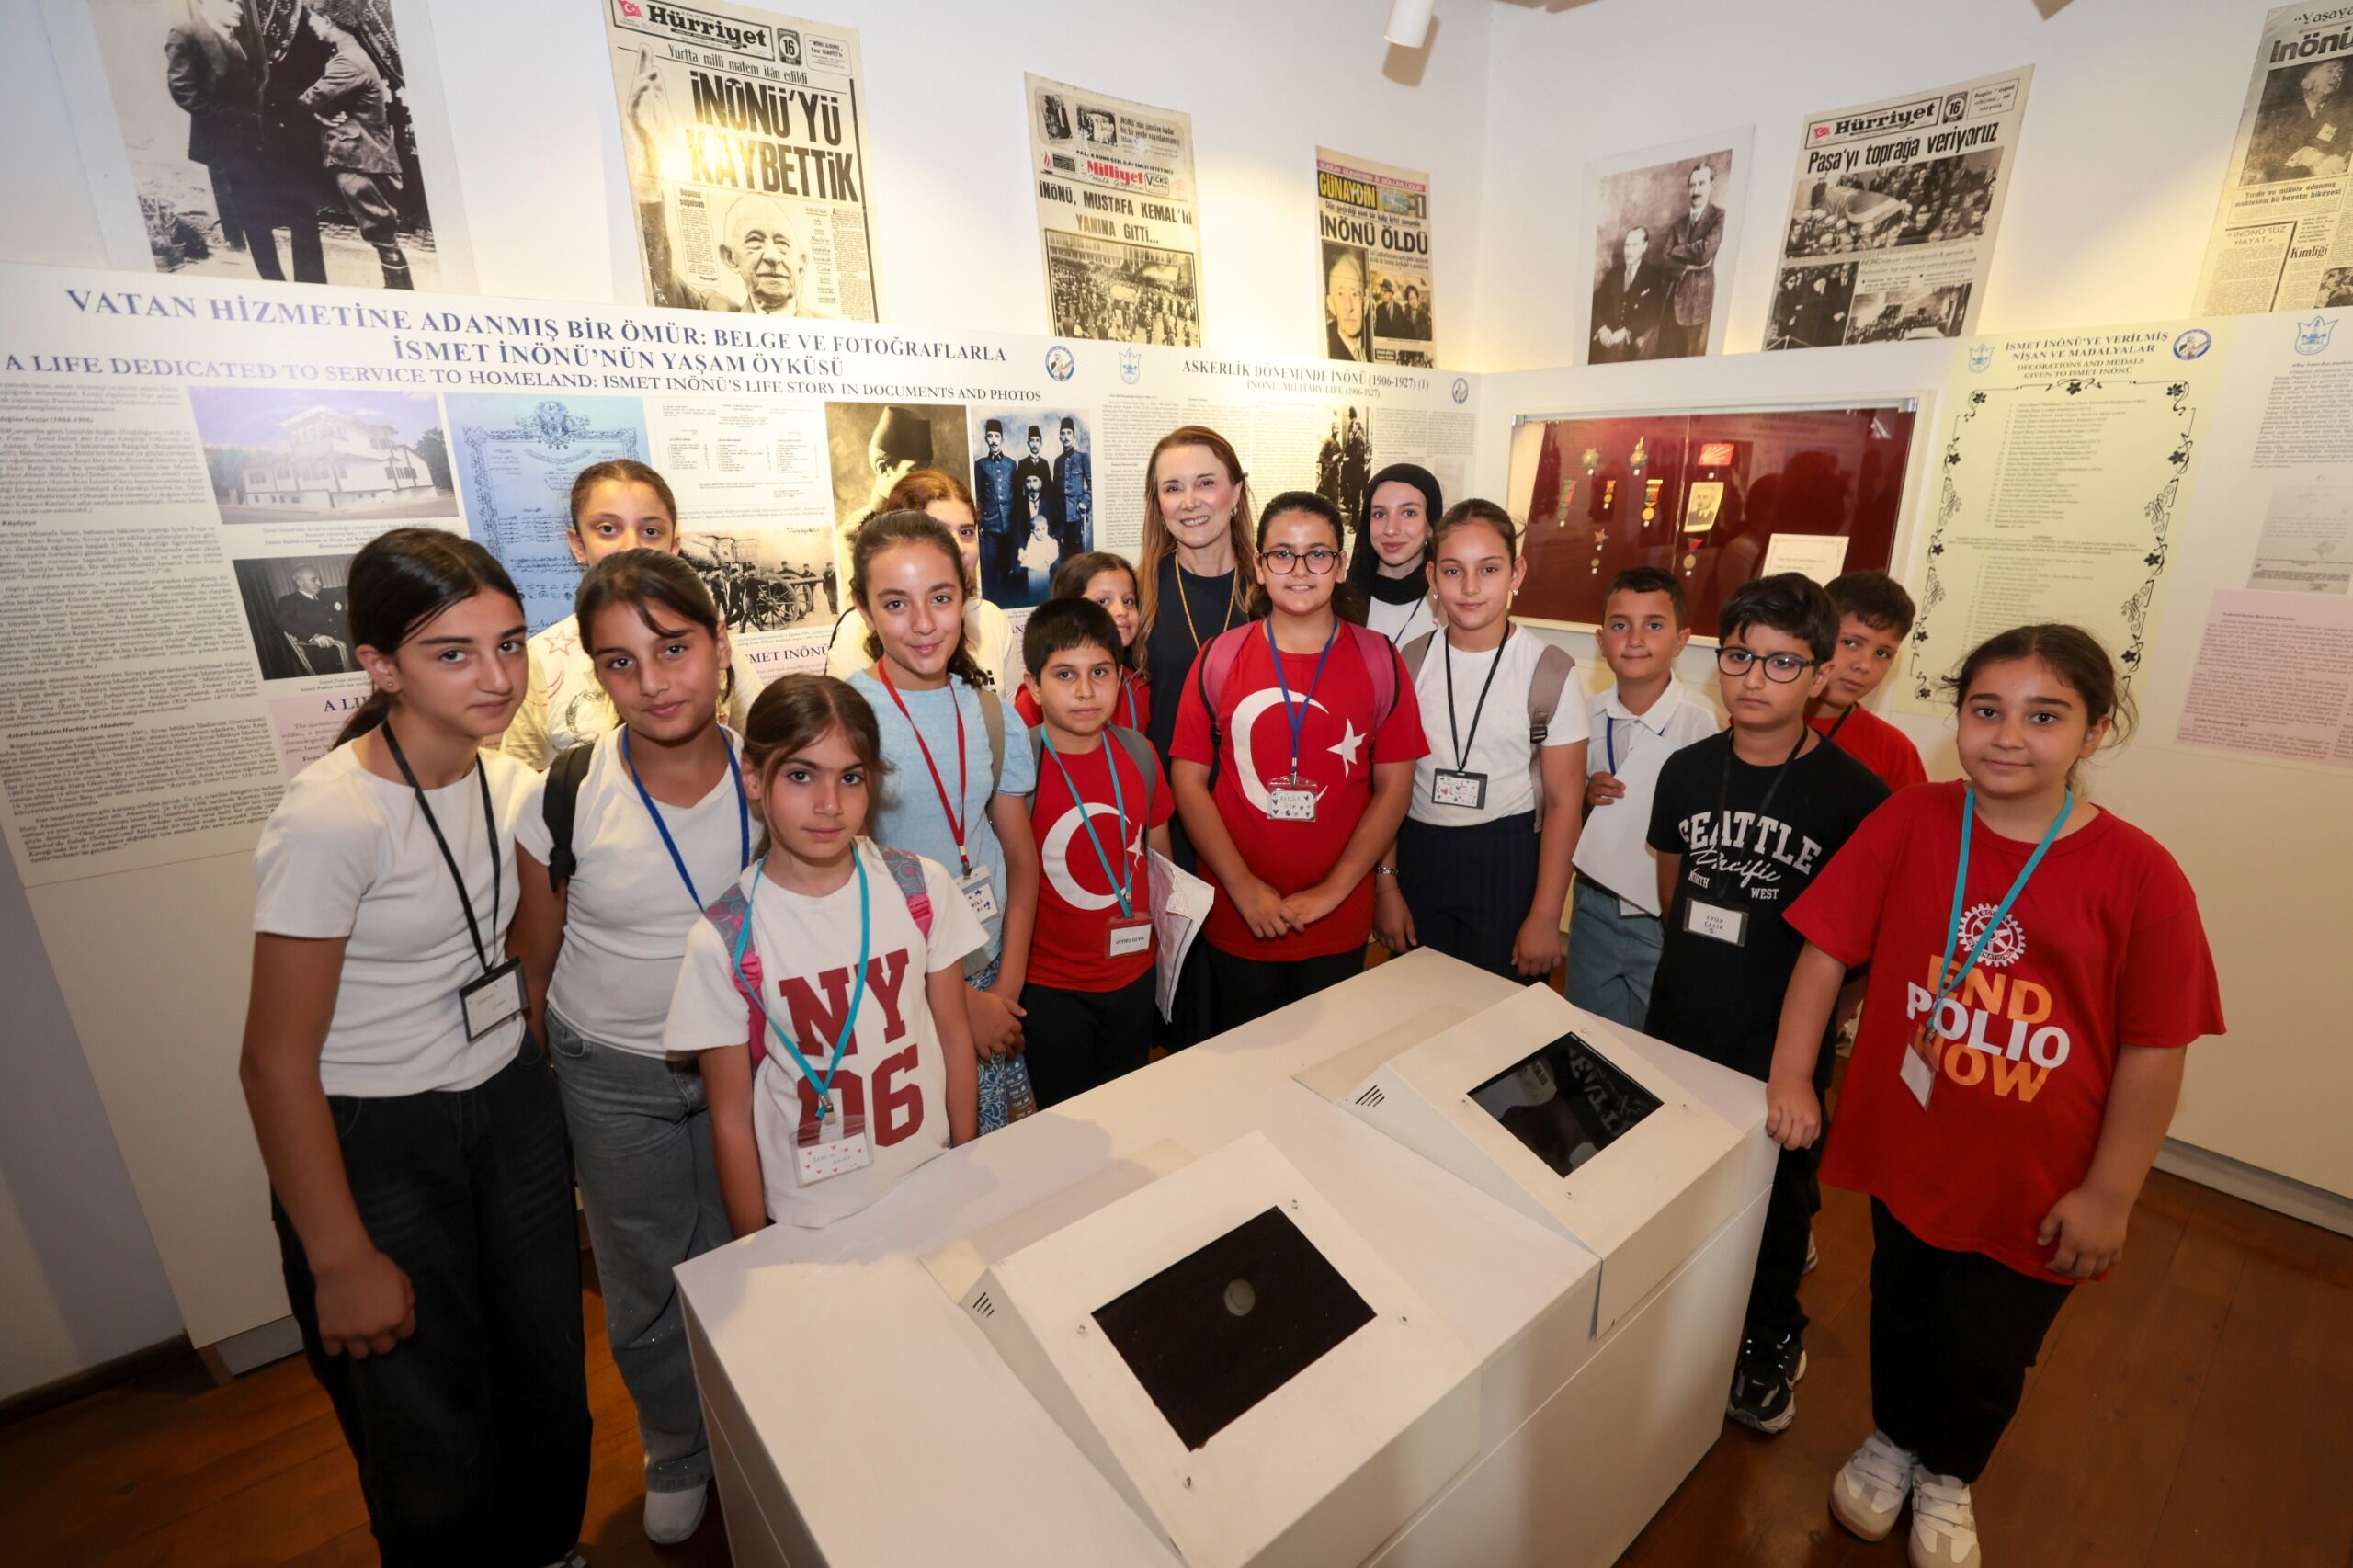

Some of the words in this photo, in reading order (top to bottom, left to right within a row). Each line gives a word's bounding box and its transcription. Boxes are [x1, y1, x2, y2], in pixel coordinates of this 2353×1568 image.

[646, 4, 767, 50] Hürriyet
[783, 39, 796, 56] 16
[668, 44, 698, 62] Yurtta
[703, 52, 724, 67] milli
[729, 58, 759, 74] matem
[783, 68, 808, 85] edildi
[690, 70, 842, 146] İNÖNÜ'YÜ
[1834, 103, 1936, 135] Hürriyet
[1949, 100, 1961, 115] 16
[1807, 148, 1859, 176] Paşa'yı
[1865, 137, 1920, 168] toprağa
[1927, 121, 1999, 154] veriyoruz
[687, 129, 858, 202] KAYBETTİK
[1087, 160, 1144, 186] Milliyet
[1145, 174, 1168, 186] VICKS
[2279, 186, 2302, 194] millete
[1083, 191, 1134, 216] MUSTAFA
[1076, 213, 1116, 237] YANINA
[1320, 210, 1375, 246] İNÖNÜ
[1381, 224, 1427, 255] ÖLDÜ
[2290, 244, 2330, 259] Kimliği
[65, 289, 198, 319] VATAN
[209, 295, 412, 331] HİZMETİNE
[421, 312, 559, 341] ADANMIŞ
[567, 317, 615, 340] BİR
[621, 320, 707, 346] ÖMÜR:
[714, 329, 791, 351] BELGE
[798, 335, 827, 351] VE
[834, 336, 1006, 362] FOTOĞRAFLARLA
[2006, 341, 2040, 351] İSMET
[2044, 336, 2102, 348] İNÖNÜ'YE
[2106, 331, 2168, 343] VERİLMİŞ
[2012, 349, 2046, 361] NİŞAN
[2051, 349, 2065, 358] VE
[2068, 345, 2155, 357] MADALYALAR
[392, 335, 490, 363] İSMET
[500, 340, 655, 369] İNÖNÜ’NÜN
[661, 351, 746, 375] YAŞAM
[752, 348, 844, 376] ÖYKÜSÜ
[2017, 360, 2081, 370] DECORATIONS
[2106, 358, 2144, 366] MEDALS
[5, 354, 24, 372] A
[31, 356, 103, 374] LIFE
[108, 358, 277, 380] DEDICATED
[285, 364, 319, 381] TO
[325, 366, 426, 383] SERVICE
[430, 369, 461, 384] TO
[469, 369, 598, 388] HOMELAND:
[603, 375, 660, 390] ISMET
[666, 375, 741, 392] INÖNÜ'S
[746, 381, 782, 393] LIFE
[787, 381, 836, 396] STORY
[841, 383, 858, 395] IN
[863, 383, 954, 399] DOCUMENTS
[958, 387, 987, 400] AND
[990, 389, 1041, 402] PHOTOS
[1182, 359, 1250, 377] ASKERLİK
[1254, 362, 1326, 382] DÖNEMİNDE
[1331, 368, 1366, 385] İNÖNÜ
[1369, 373, 1416, 390] (1906-1927)
[2068, 369, 2097, 377] ISMET
[1283, 381, 1323, 393] MILITARY
[1325, 384, 1343, 395] LIFE
[1345, 387, 1380, 398] (1906-1927)
[324, 699, 336, 712] A
[1678, 810, 1823, 875] SEATTLE
[1688, 868, 1710, 889] NORTH
[1689, 845, 1781, 889] Pacific
[1751, 887, 1779, 900] WEST
[778, 948, 910, 1058] NY
[1927, 954, 2052, 1024] END
[1906, 981, 2070, 1069] POLIO
